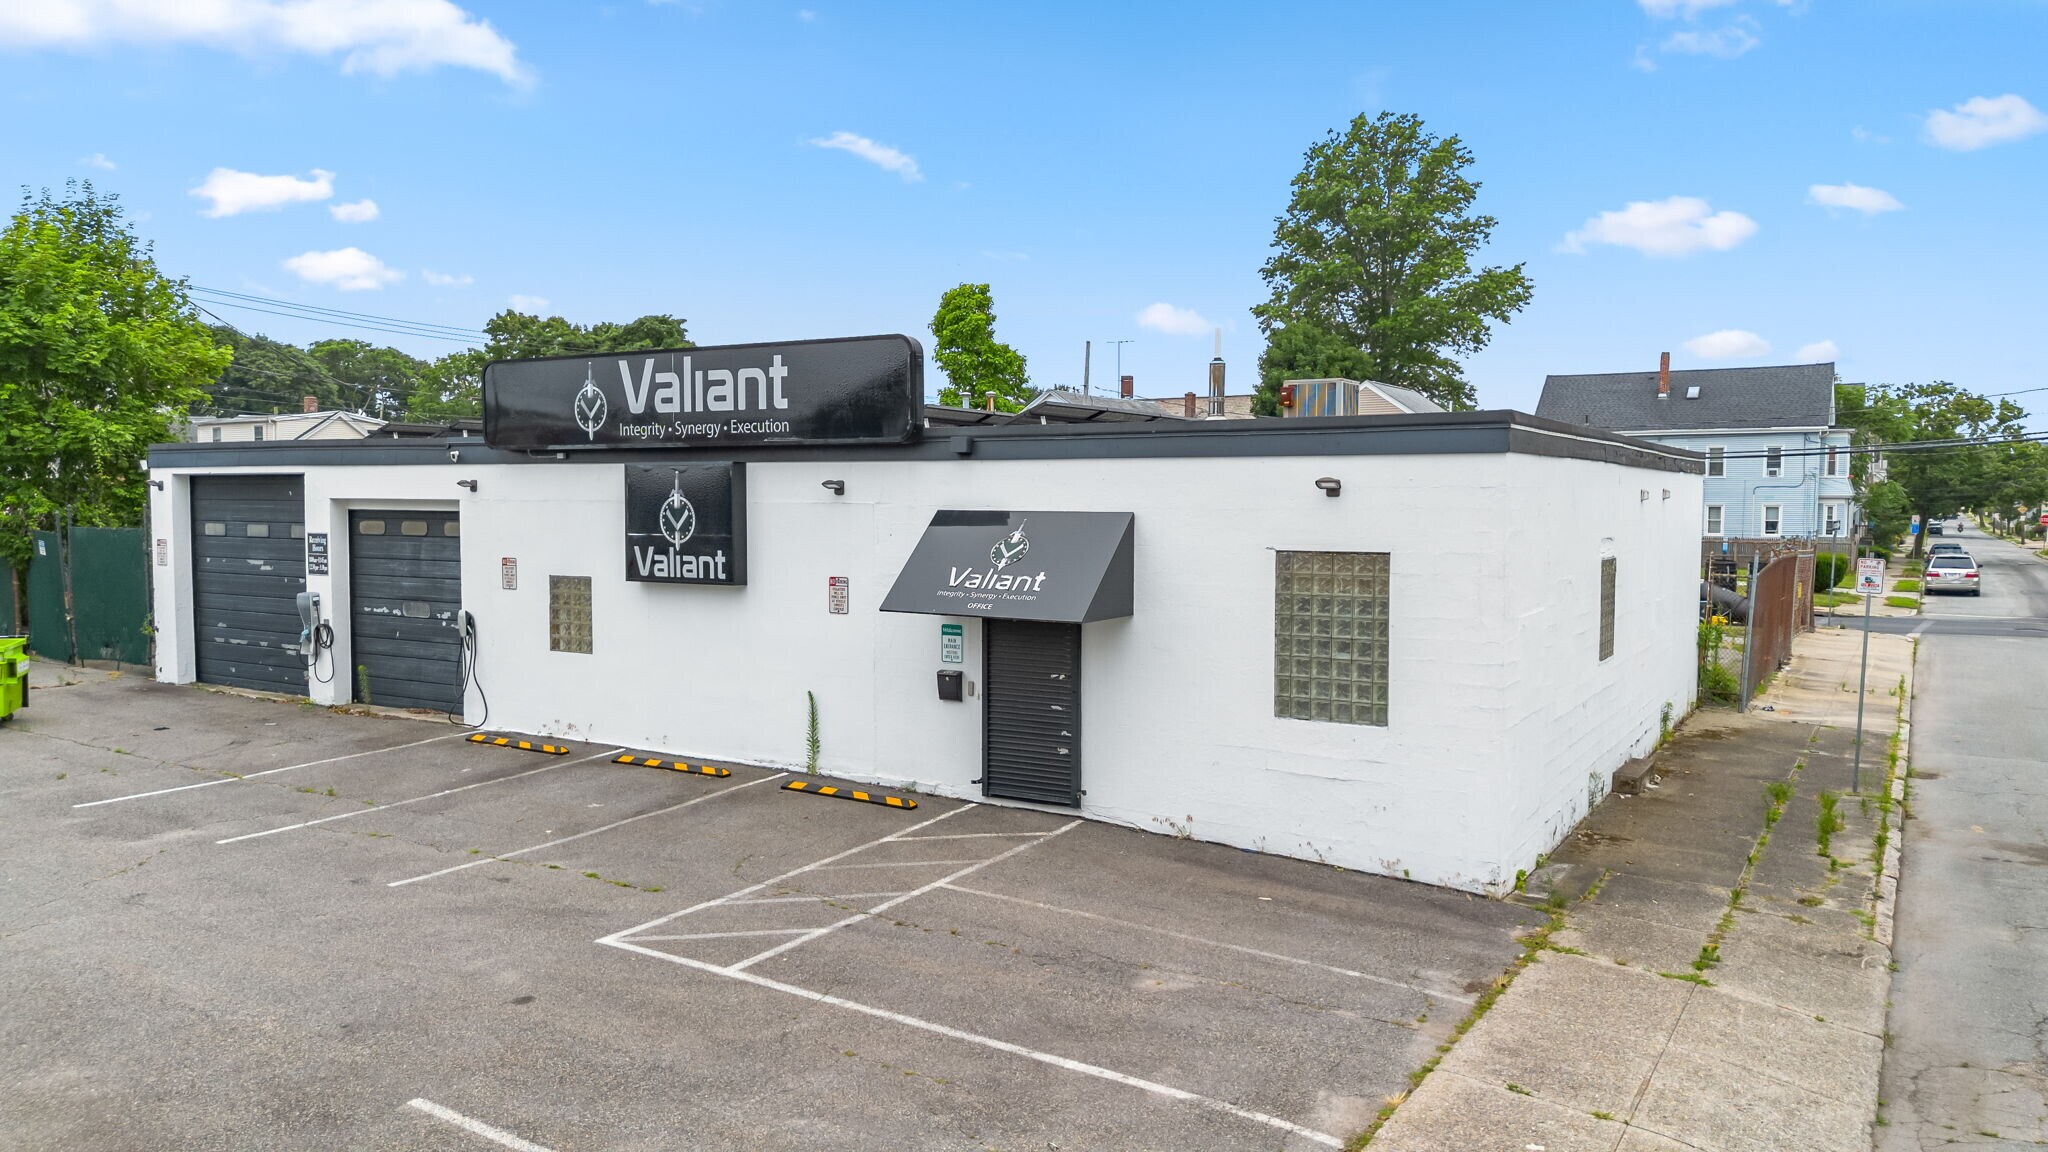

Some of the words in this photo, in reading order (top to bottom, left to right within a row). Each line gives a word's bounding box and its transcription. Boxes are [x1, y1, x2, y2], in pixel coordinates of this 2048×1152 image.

[618, 354, 789, 414] Valiant
[619, 422, 666, 438] Integrity
[675, 421, 721, 438] Synergy
[730, 419, 790, 434] Execution
[633, 545, 726, 580] Valiant
[949, 566, 1046, 592] Valiant
[936, 590, 965, 599] Integrity
[969, 591, 997, 600] Synergy
[1002, 592, 1037, 601] Execution
[967, 602, 993, 610] OFFICE
